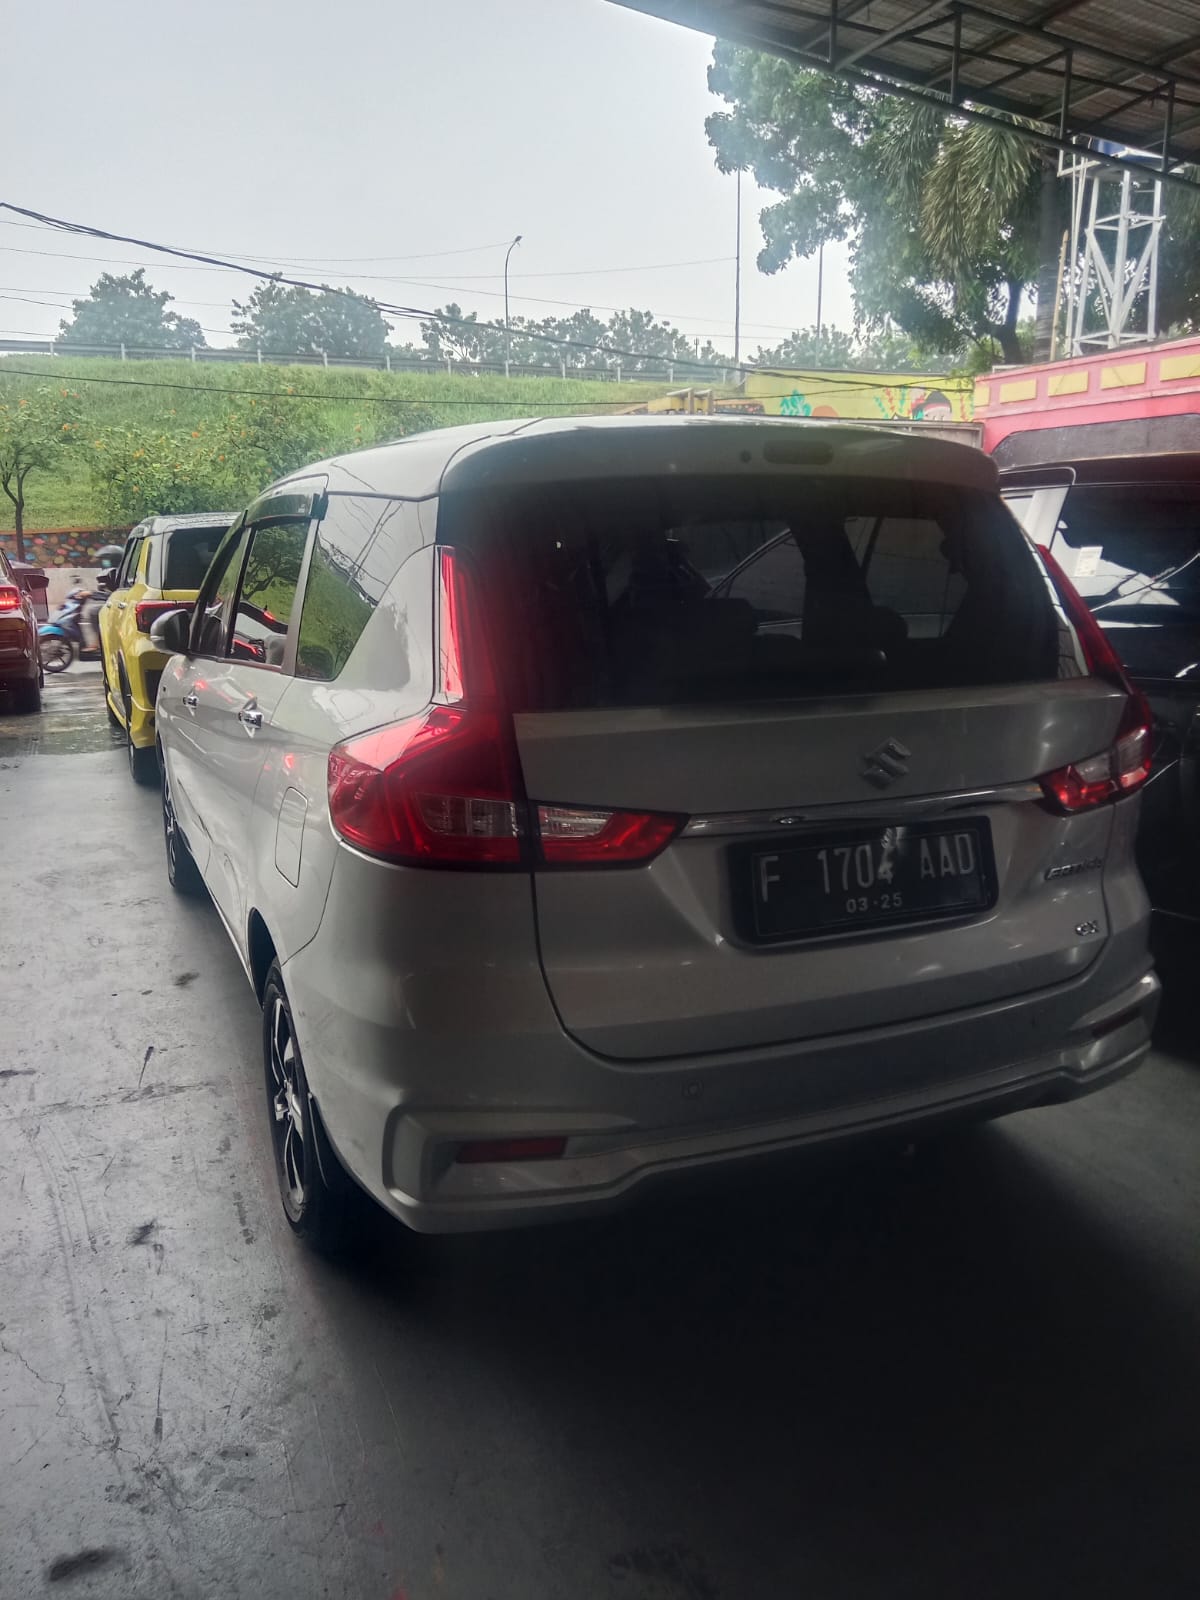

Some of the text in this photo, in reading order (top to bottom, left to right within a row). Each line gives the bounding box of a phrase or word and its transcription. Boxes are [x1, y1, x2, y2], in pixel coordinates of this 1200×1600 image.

[760, 833, 976, 903] F 1704 AAD
